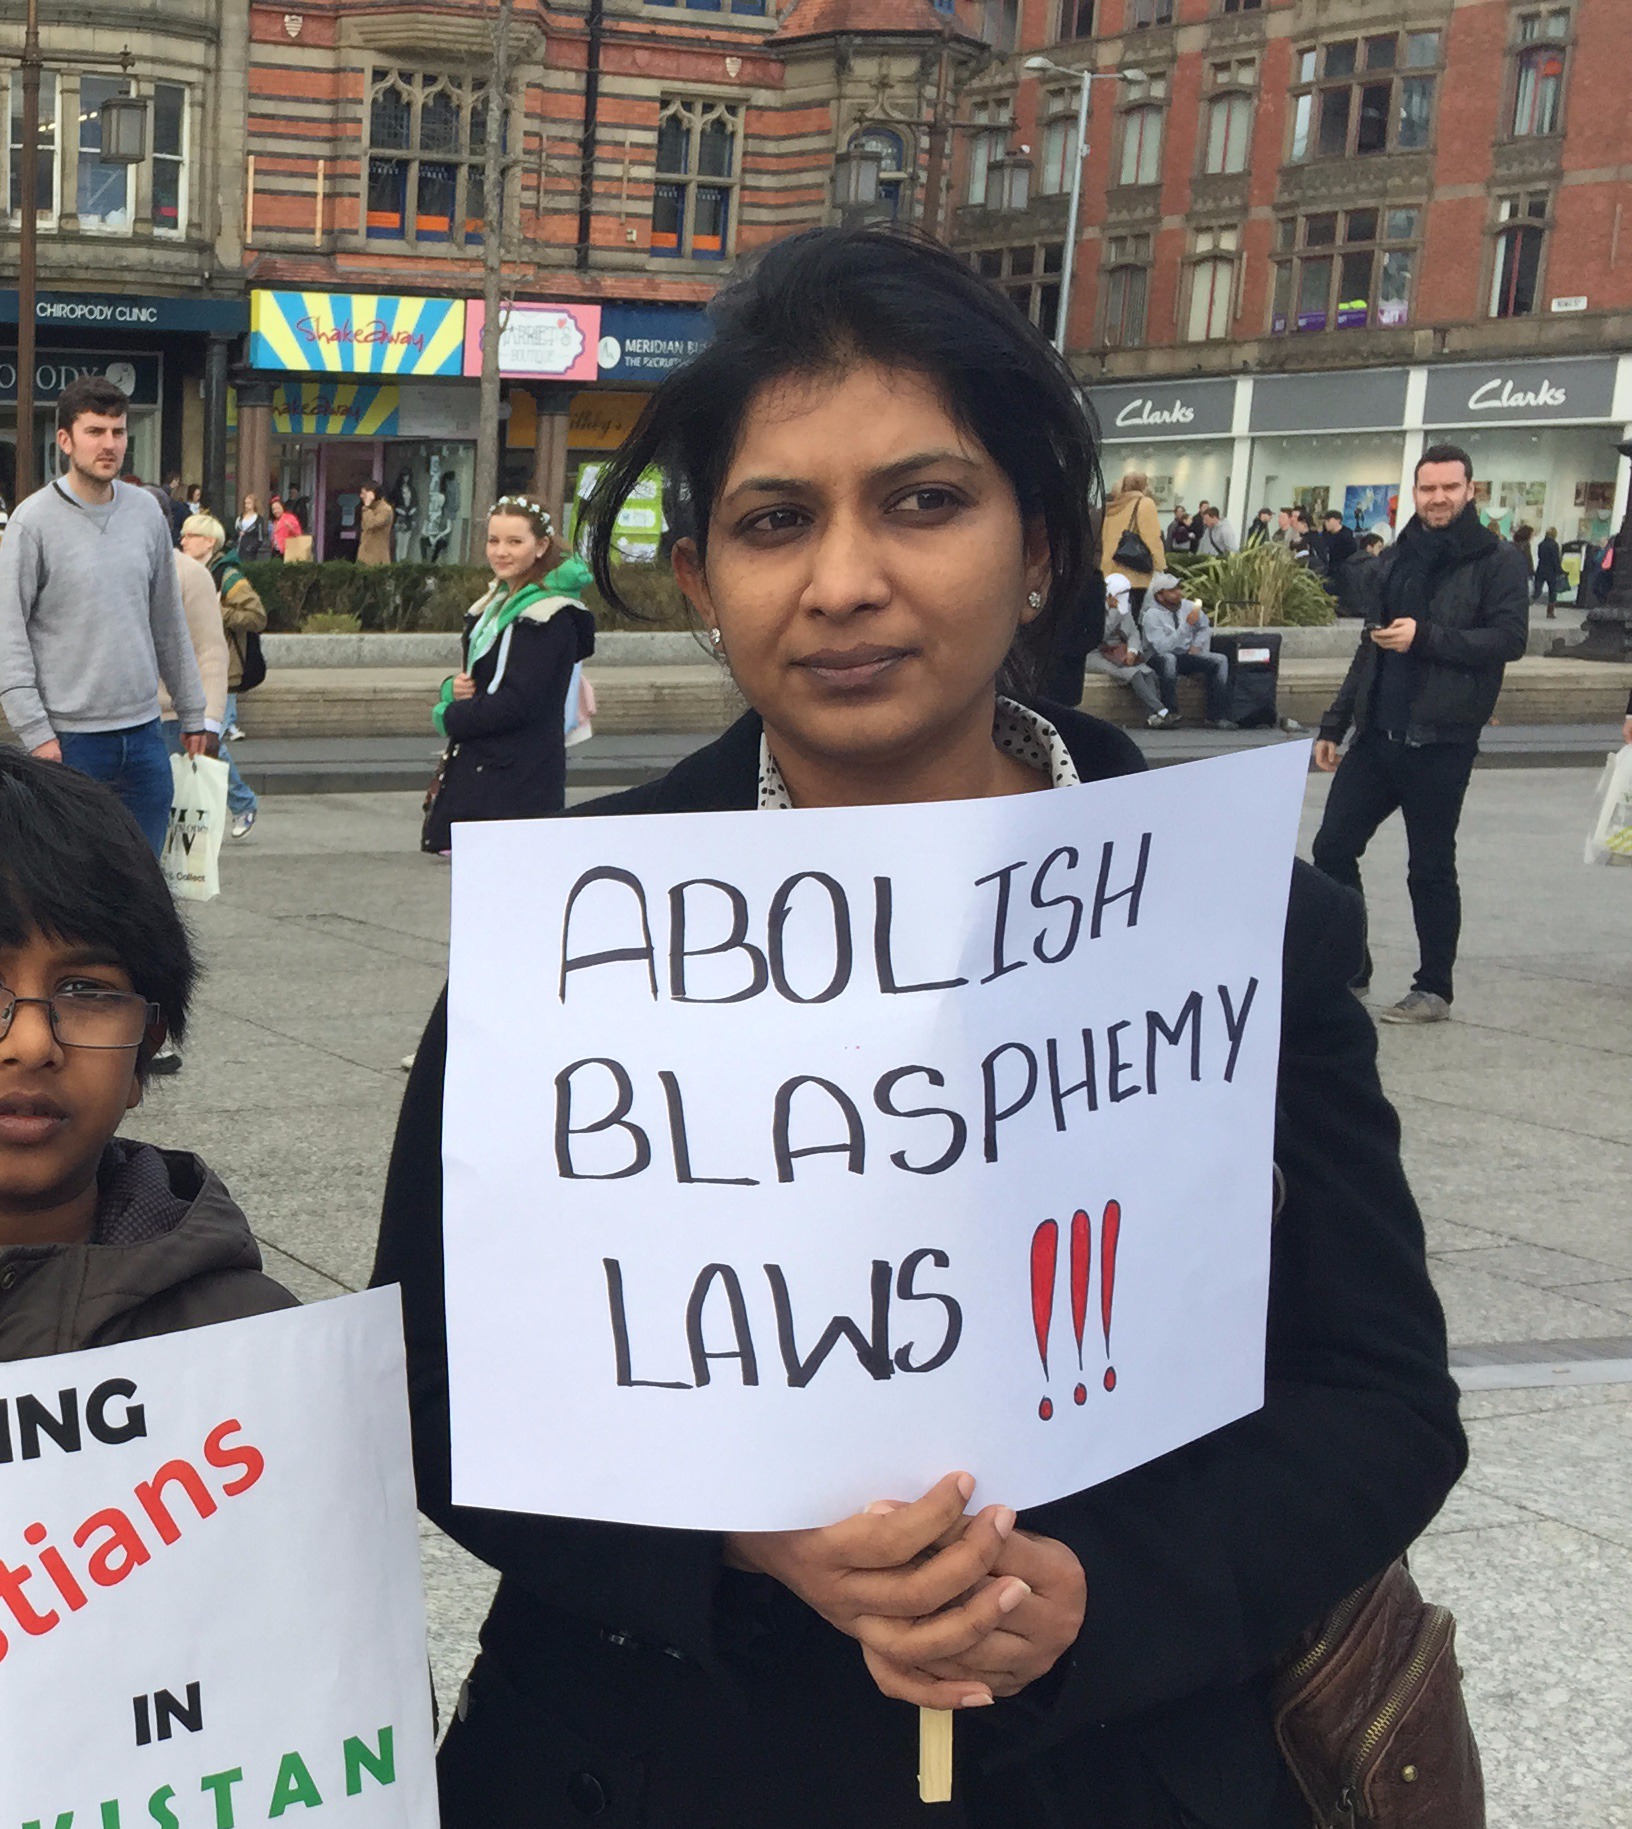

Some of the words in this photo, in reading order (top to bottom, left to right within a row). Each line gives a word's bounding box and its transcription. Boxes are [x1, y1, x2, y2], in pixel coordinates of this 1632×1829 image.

[36, 302, 114, 320] CHIROPODY
[115, 306, 158, 323] CLINIC
[625, 338, 684, 355] MERIDIAN
[1115, 399, 1195, 427] Clarks
[1468, 378, 1566, 410] Clarks
[559, 832, 1153, 1005] ABOLISH
[553, 976, 1261, 1187] BLASPHEMY
[602, 1247, 964, 1390] LAWS
[132, 1681, 204, 1747] IN
